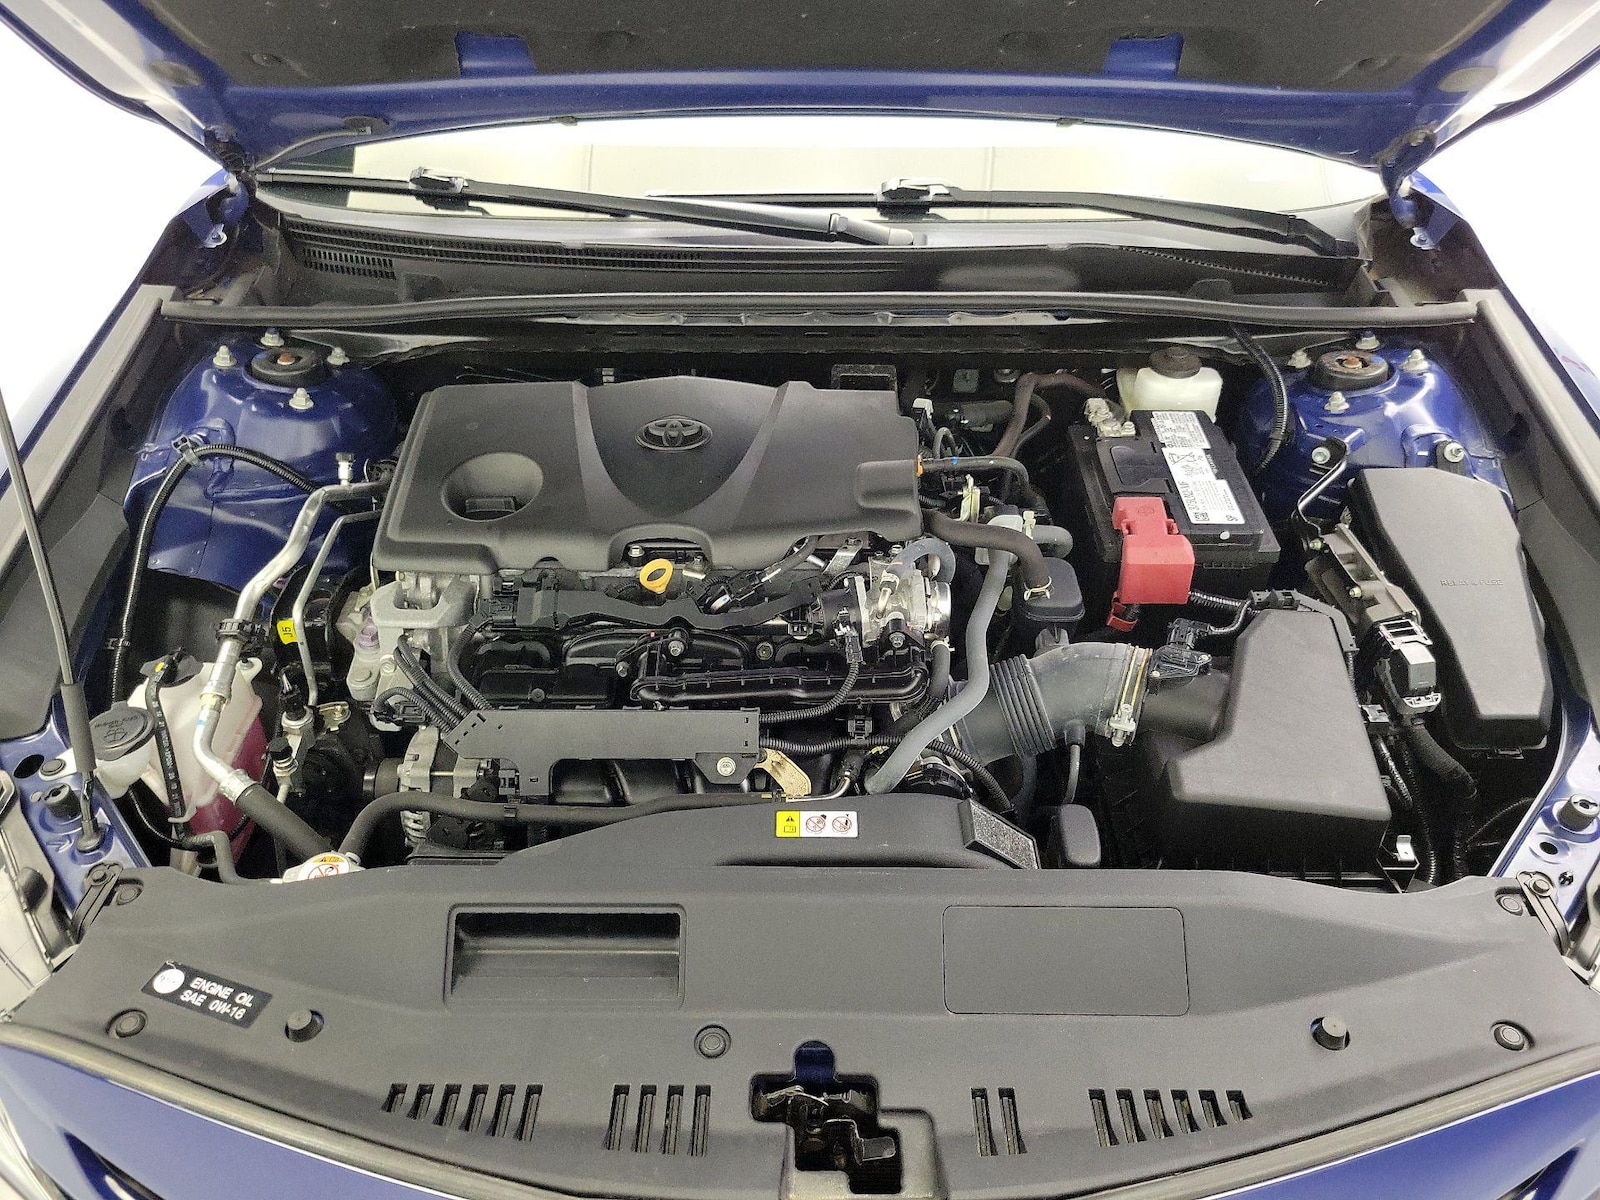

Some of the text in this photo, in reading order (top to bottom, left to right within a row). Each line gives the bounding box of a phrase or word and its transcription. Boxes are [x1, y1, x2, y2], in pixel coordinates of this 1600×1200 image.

[1439, 578, 1468, 587] RELAY
[1479, 578, 1504, 587] FUSE
[180, 989, 247, 1020] SAE 0W-16
[190, 977, 255, 1008] ENGINE OIL
